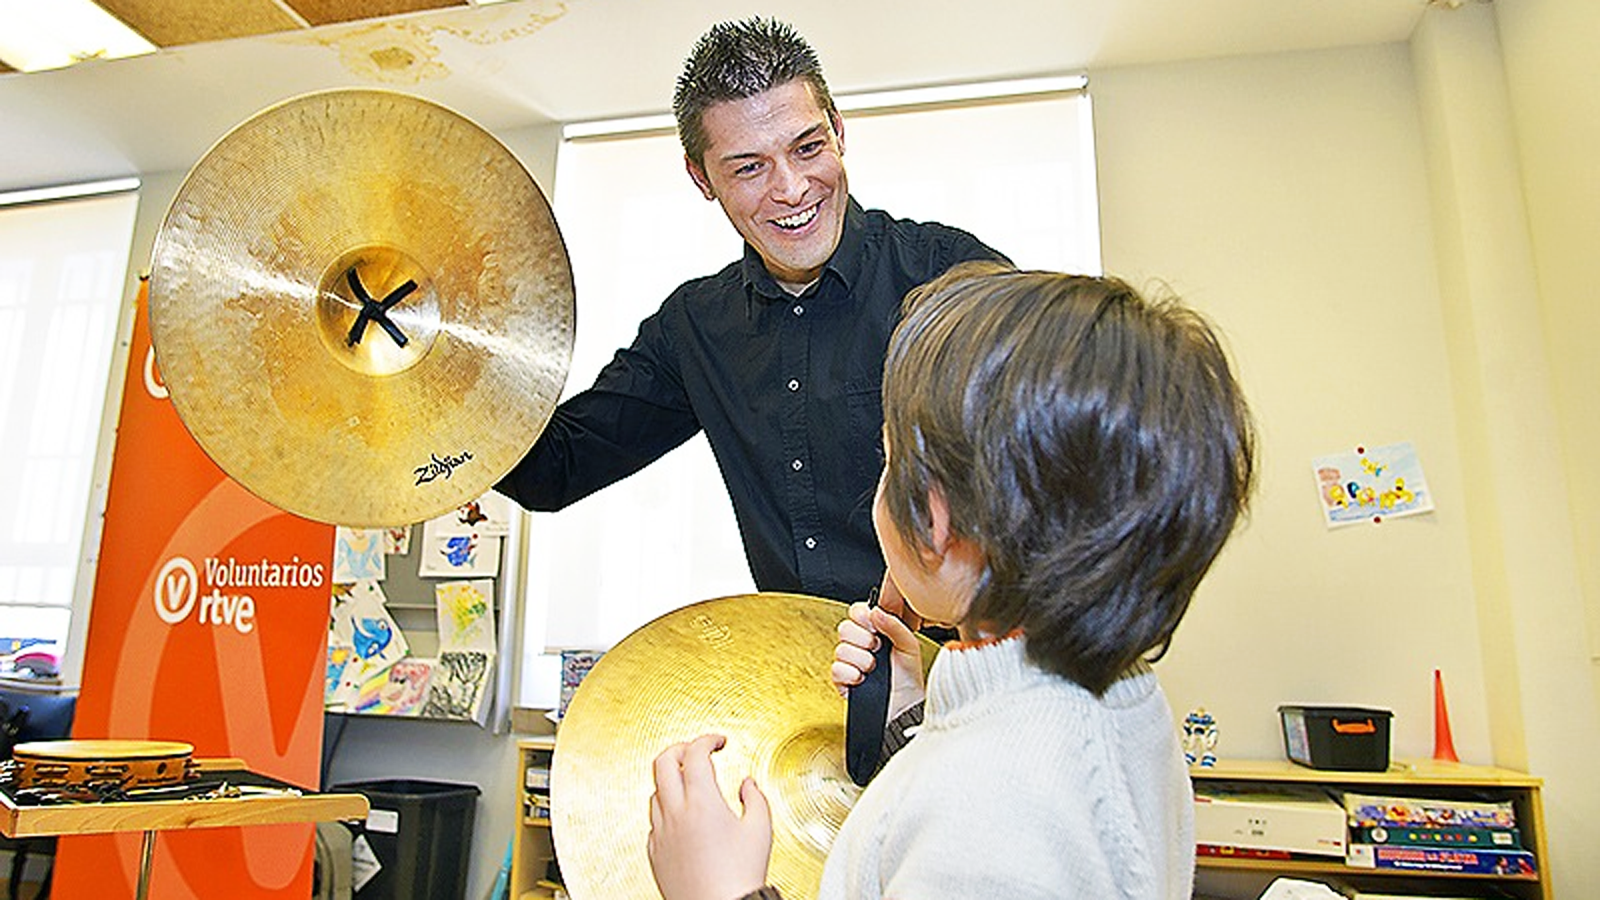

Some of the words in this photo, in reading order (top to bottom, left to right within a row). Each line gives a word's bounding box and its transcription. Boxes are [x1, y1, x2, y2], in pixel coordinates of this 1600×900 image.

[413, 452, 474, 486] Zildjian
[205, 556, 324, 588] Voluntarios
[199, 588, 256, 634] rtve
